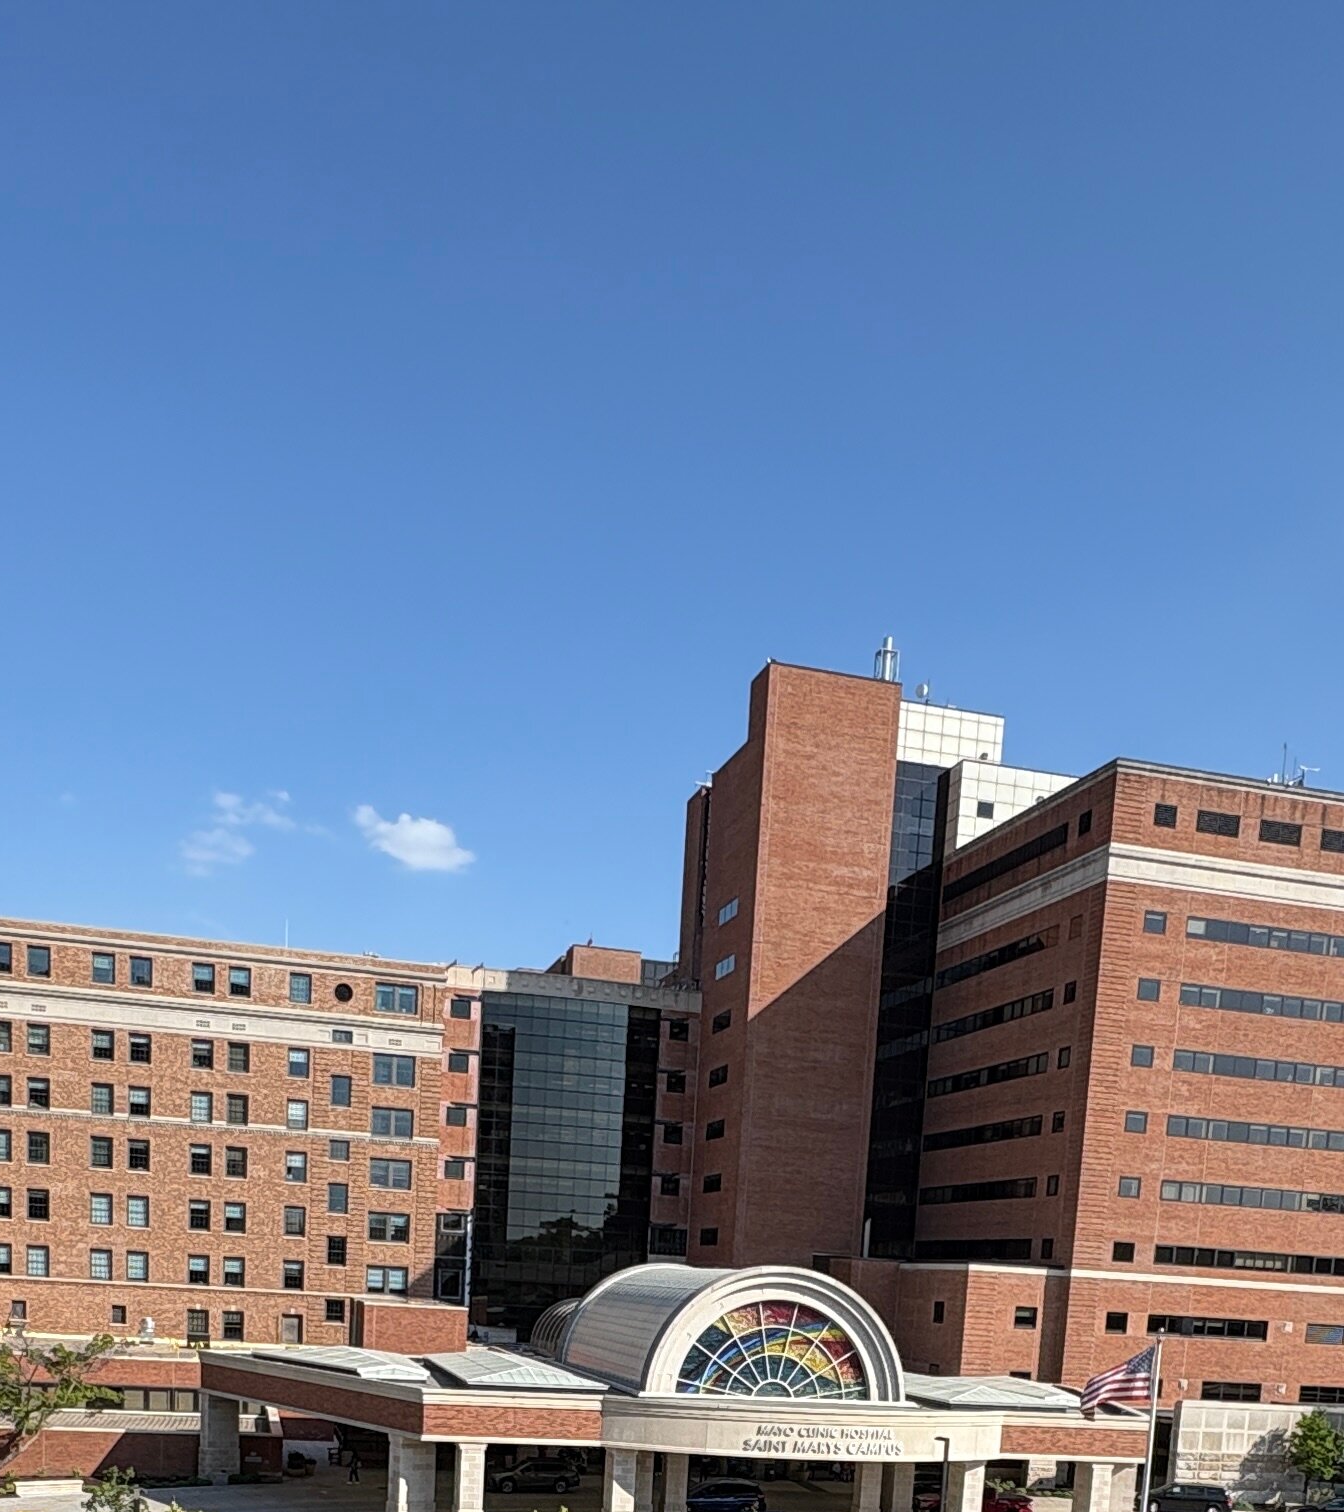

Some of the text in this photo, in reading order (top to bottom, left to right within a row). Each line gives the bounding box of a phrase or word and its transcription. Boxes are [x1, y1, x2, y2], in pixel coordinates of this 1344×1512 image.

[756, 1424, 894, 1441] MAYO CLINIC HOSPITAL
[741, 1438, 904, 1456] SAINT MARYS CAMPUS
